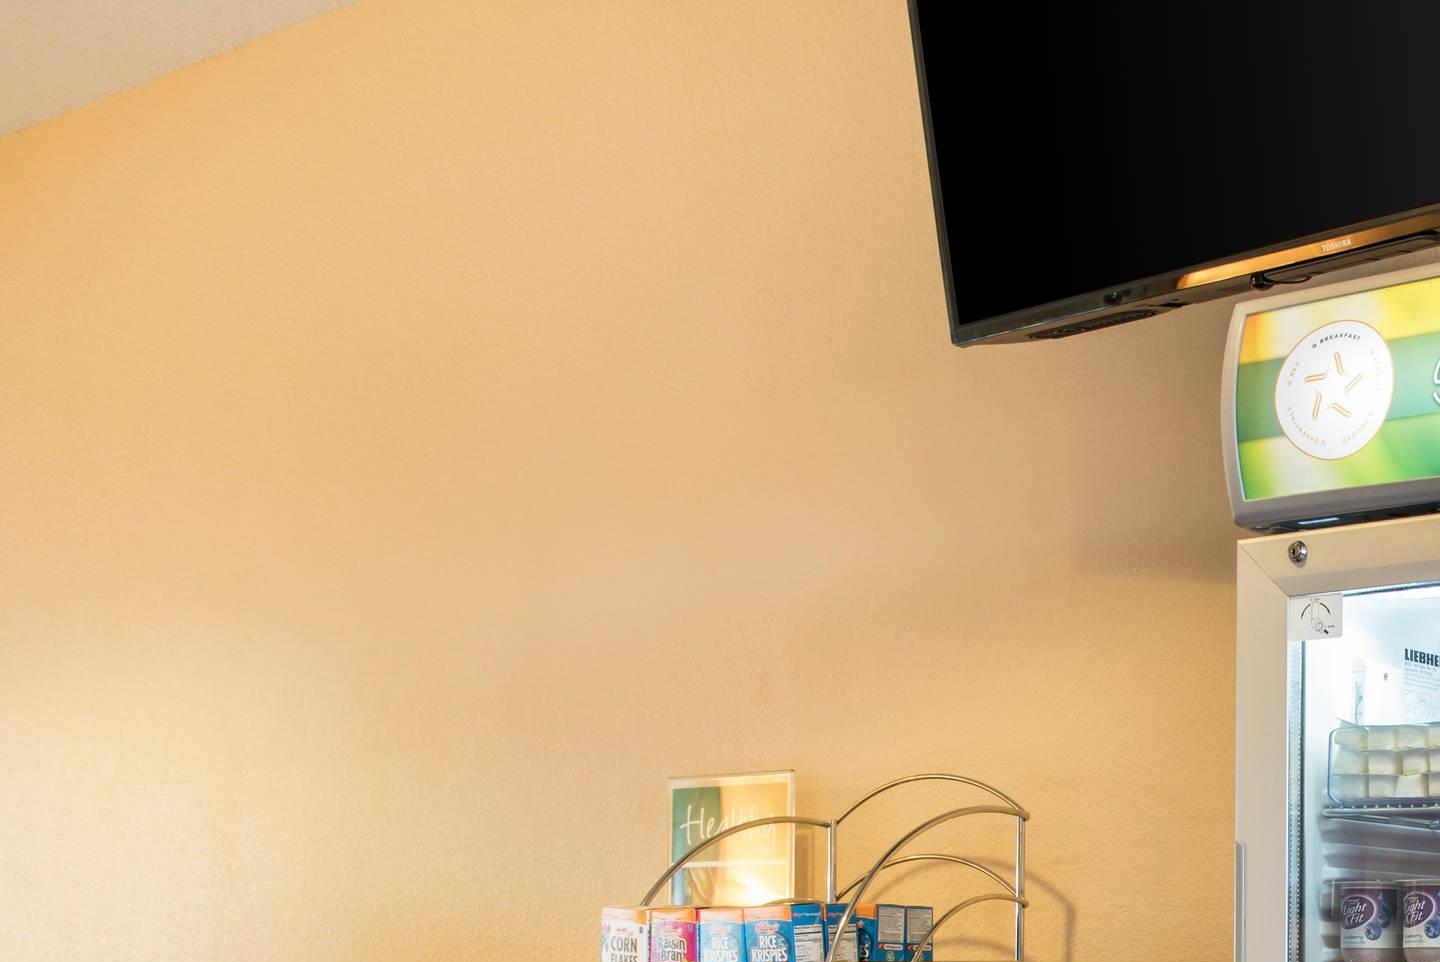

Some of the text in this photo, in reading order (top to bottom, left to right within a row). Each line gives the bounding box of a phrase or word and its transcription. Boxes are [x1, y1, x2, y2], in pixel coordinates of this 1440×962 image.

[1322, 239, 1352, 252] TOSHIBA
[1319, 332, 1361, 344] BREAKFAST
[1343, 902, 1366, 917] Light
[1405, 900, 1426, 917] Light
[610, 936, 638, 953] CORN
[658, 936, 685, 951] Raisin
[711, 936, 729, 949] RICE
[759, 935, 777, 948] RICE
[660, 949, 683, 962] Bran
[704, 950, 738, 962] KRISPIES
[751, 948, 787, 962] KRISPIES
